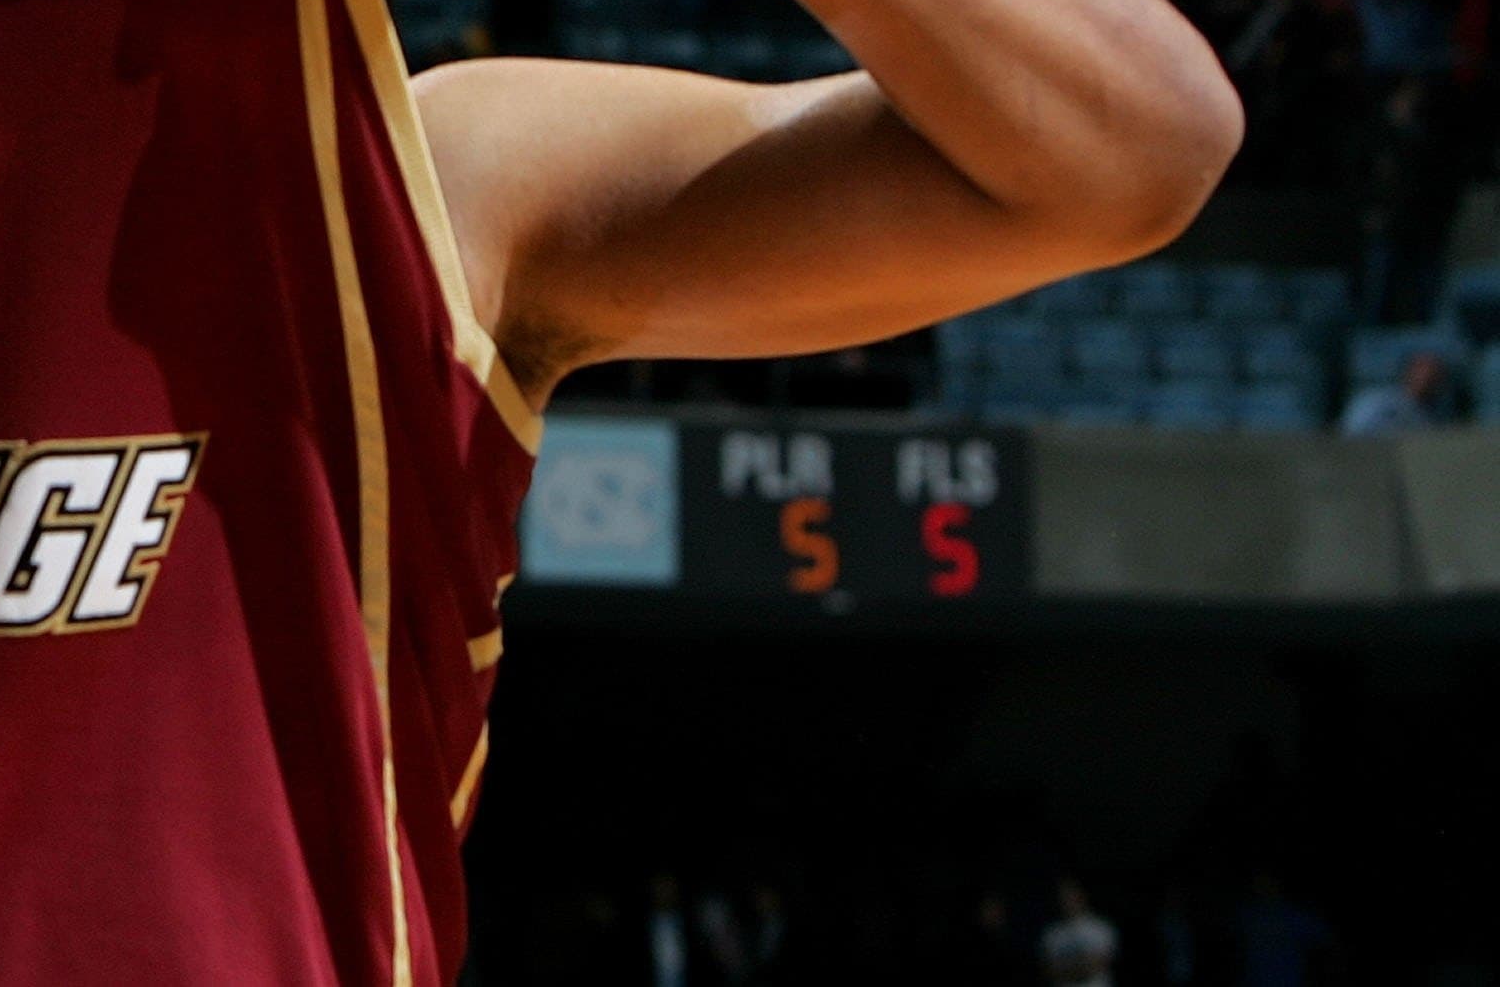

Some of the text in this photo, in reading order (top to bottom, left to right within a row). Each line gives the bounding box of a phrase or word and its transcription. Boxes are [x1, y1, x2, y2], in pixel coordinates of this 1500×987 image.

[720, 431, 1000, 507] PLR FLS
[779, 495, 980, 598] 5 5
